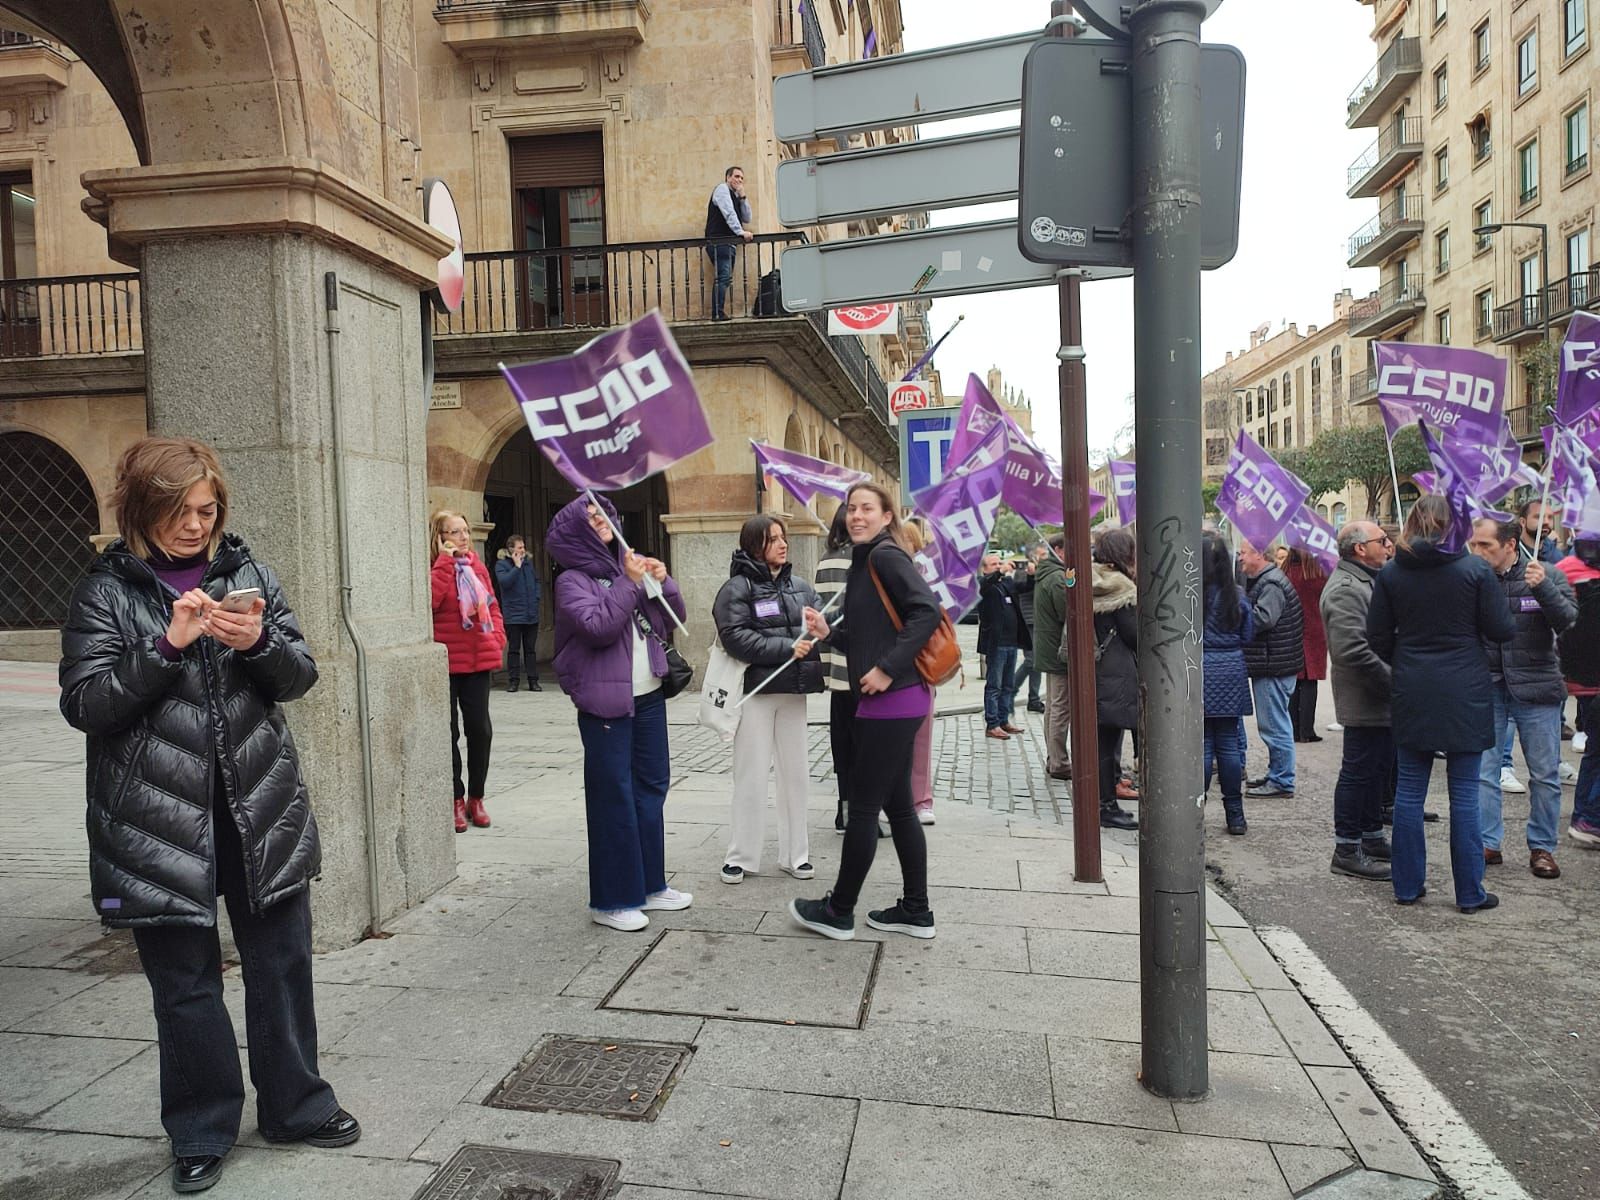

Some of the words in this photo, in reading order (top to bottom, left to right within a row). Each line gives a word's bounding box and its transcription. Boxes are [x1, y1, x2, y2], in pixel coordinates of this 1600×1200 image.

[894, 391, 924, 405] UGT
[1378, 365, 1495, 413] CCOO
[584, 419, 642, 459] mujer
[1005, 460, 1030, 480] illa
[1032, 471, 1045, 487] y
